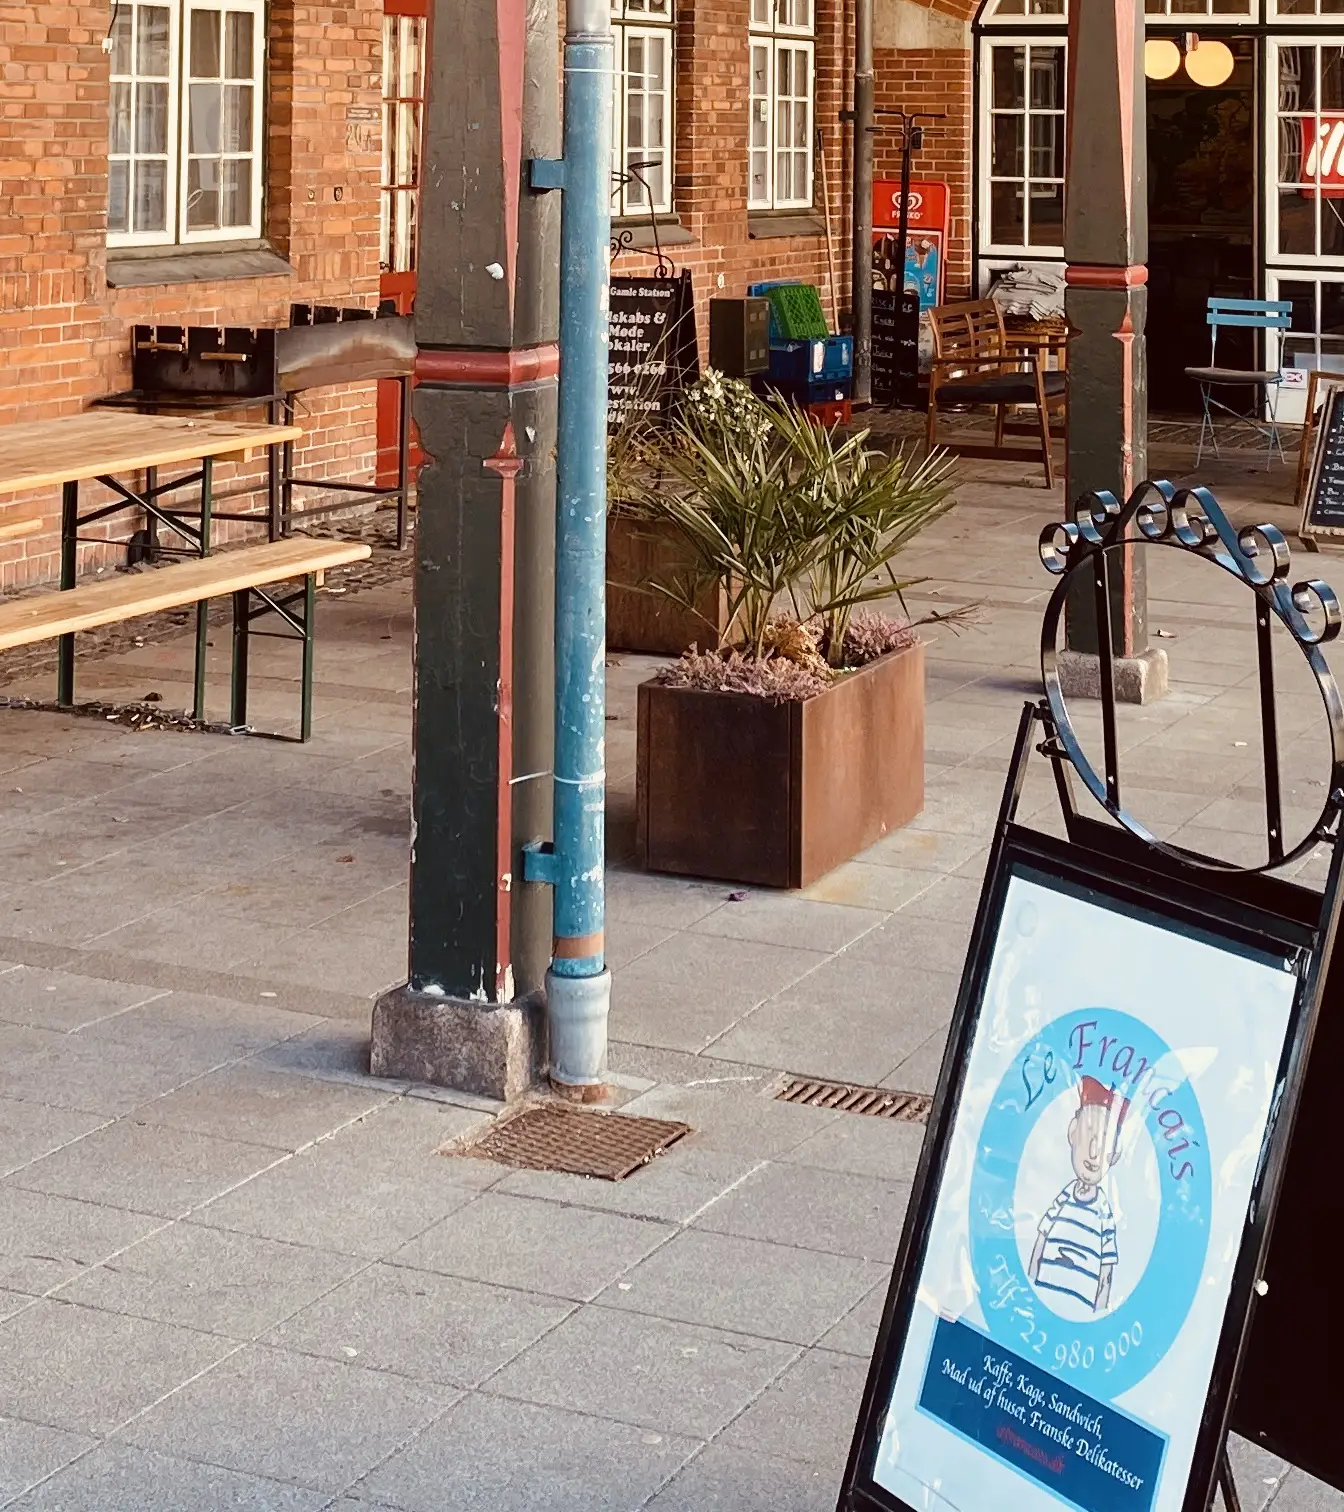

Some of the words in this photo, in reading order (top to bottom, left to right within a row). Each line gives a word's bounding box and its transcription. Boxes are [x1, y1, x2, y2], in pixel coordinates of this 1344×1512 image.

[607, 311, 651, 324] lskabs
[653, 312, 667, 325] &
[608, 339, 651, 352] okaler
[1022, 1050, 1058, 1112] Le
[1020, 1320, 1048, 1355] 22
[1051, 1339, 1095, 1371] 980
[1104, 1320, 1144, 1373] 900
[941, 1358, 972, 1386] Mad
[968, 1376, 988, 1396] ud
[983, 1386, 998, 1409] af
[997, 1388, 1027, 1425] huset,
[1029, 1410, 1074, 1451] Franske
[1076, 1438, 1144, 1491] Delikatesser
[983, 1354, 1014, 1388] Kaffe,
[1017, 1374, 1046, 1408] Kage,
[1048, 1393, 1103, 1440] Sandwich,
